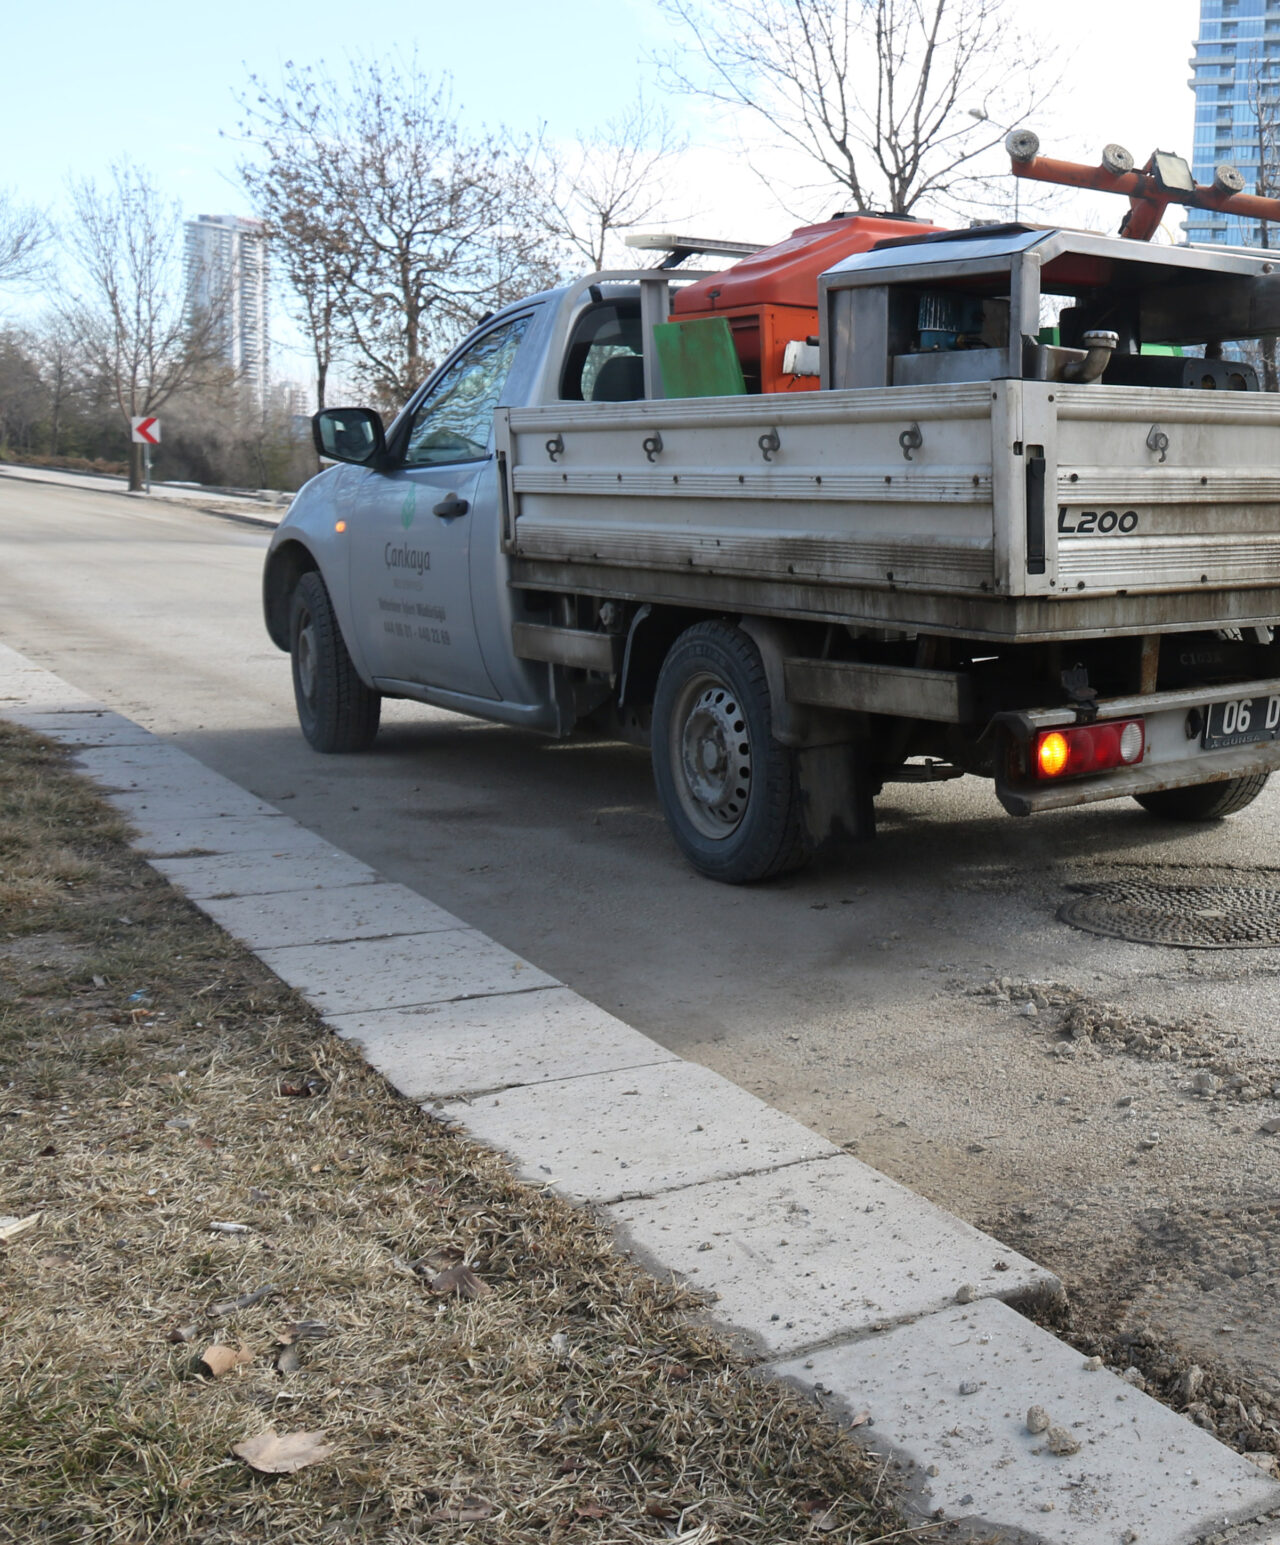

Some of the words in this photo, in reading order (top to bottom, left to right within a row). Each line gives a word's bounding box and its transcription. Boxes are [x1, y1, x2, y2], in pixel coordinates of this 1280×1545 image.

[1058, 507, 1139, 533] L200
[384, 542, 431, 576] Çankaya
[1222, 699, 1253, 734] 06
